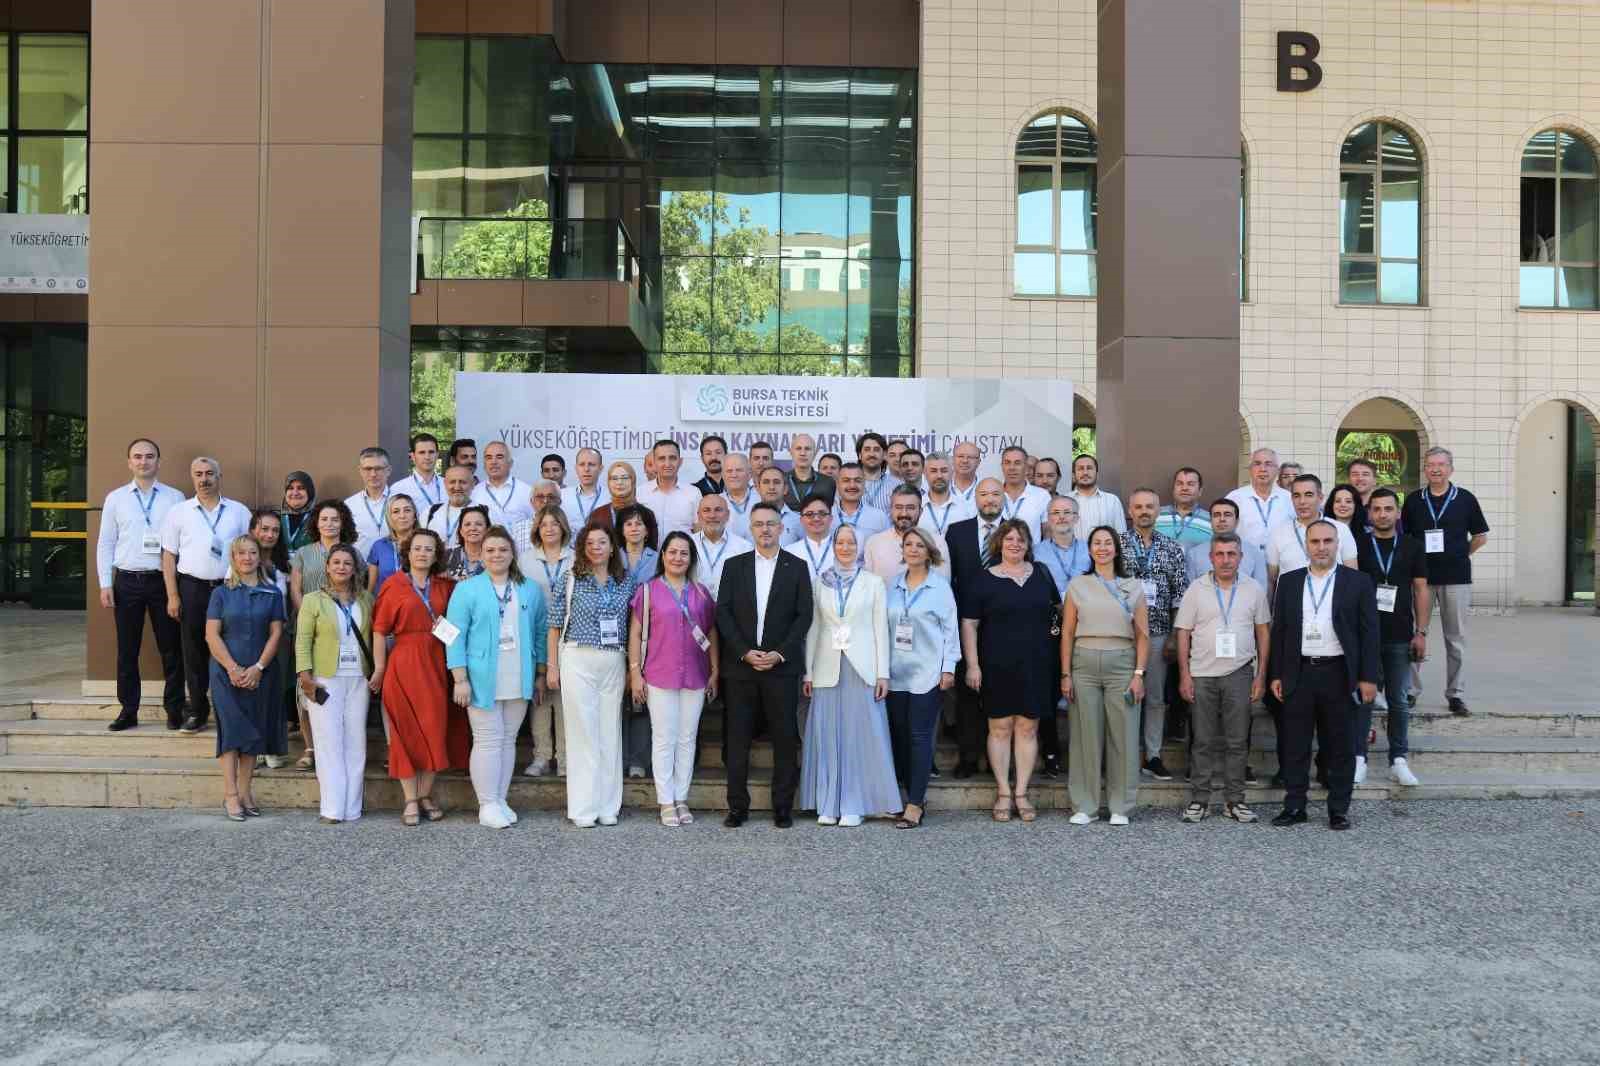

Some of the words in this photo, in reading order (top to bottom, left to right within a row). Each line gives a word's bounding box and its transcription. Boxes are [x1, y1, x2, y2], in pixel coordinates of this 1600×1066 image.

[1276, 31, 1323, 92] B
[732, 388, 778, 401] BURSA
[781, 386, 829, 401] TEKNİK
[732, 402, 829, 417] ÜNİVERSİTESİ
[670, 426, 725, 451] İNS
[731, 432, 845, 452] KAYNAARI
